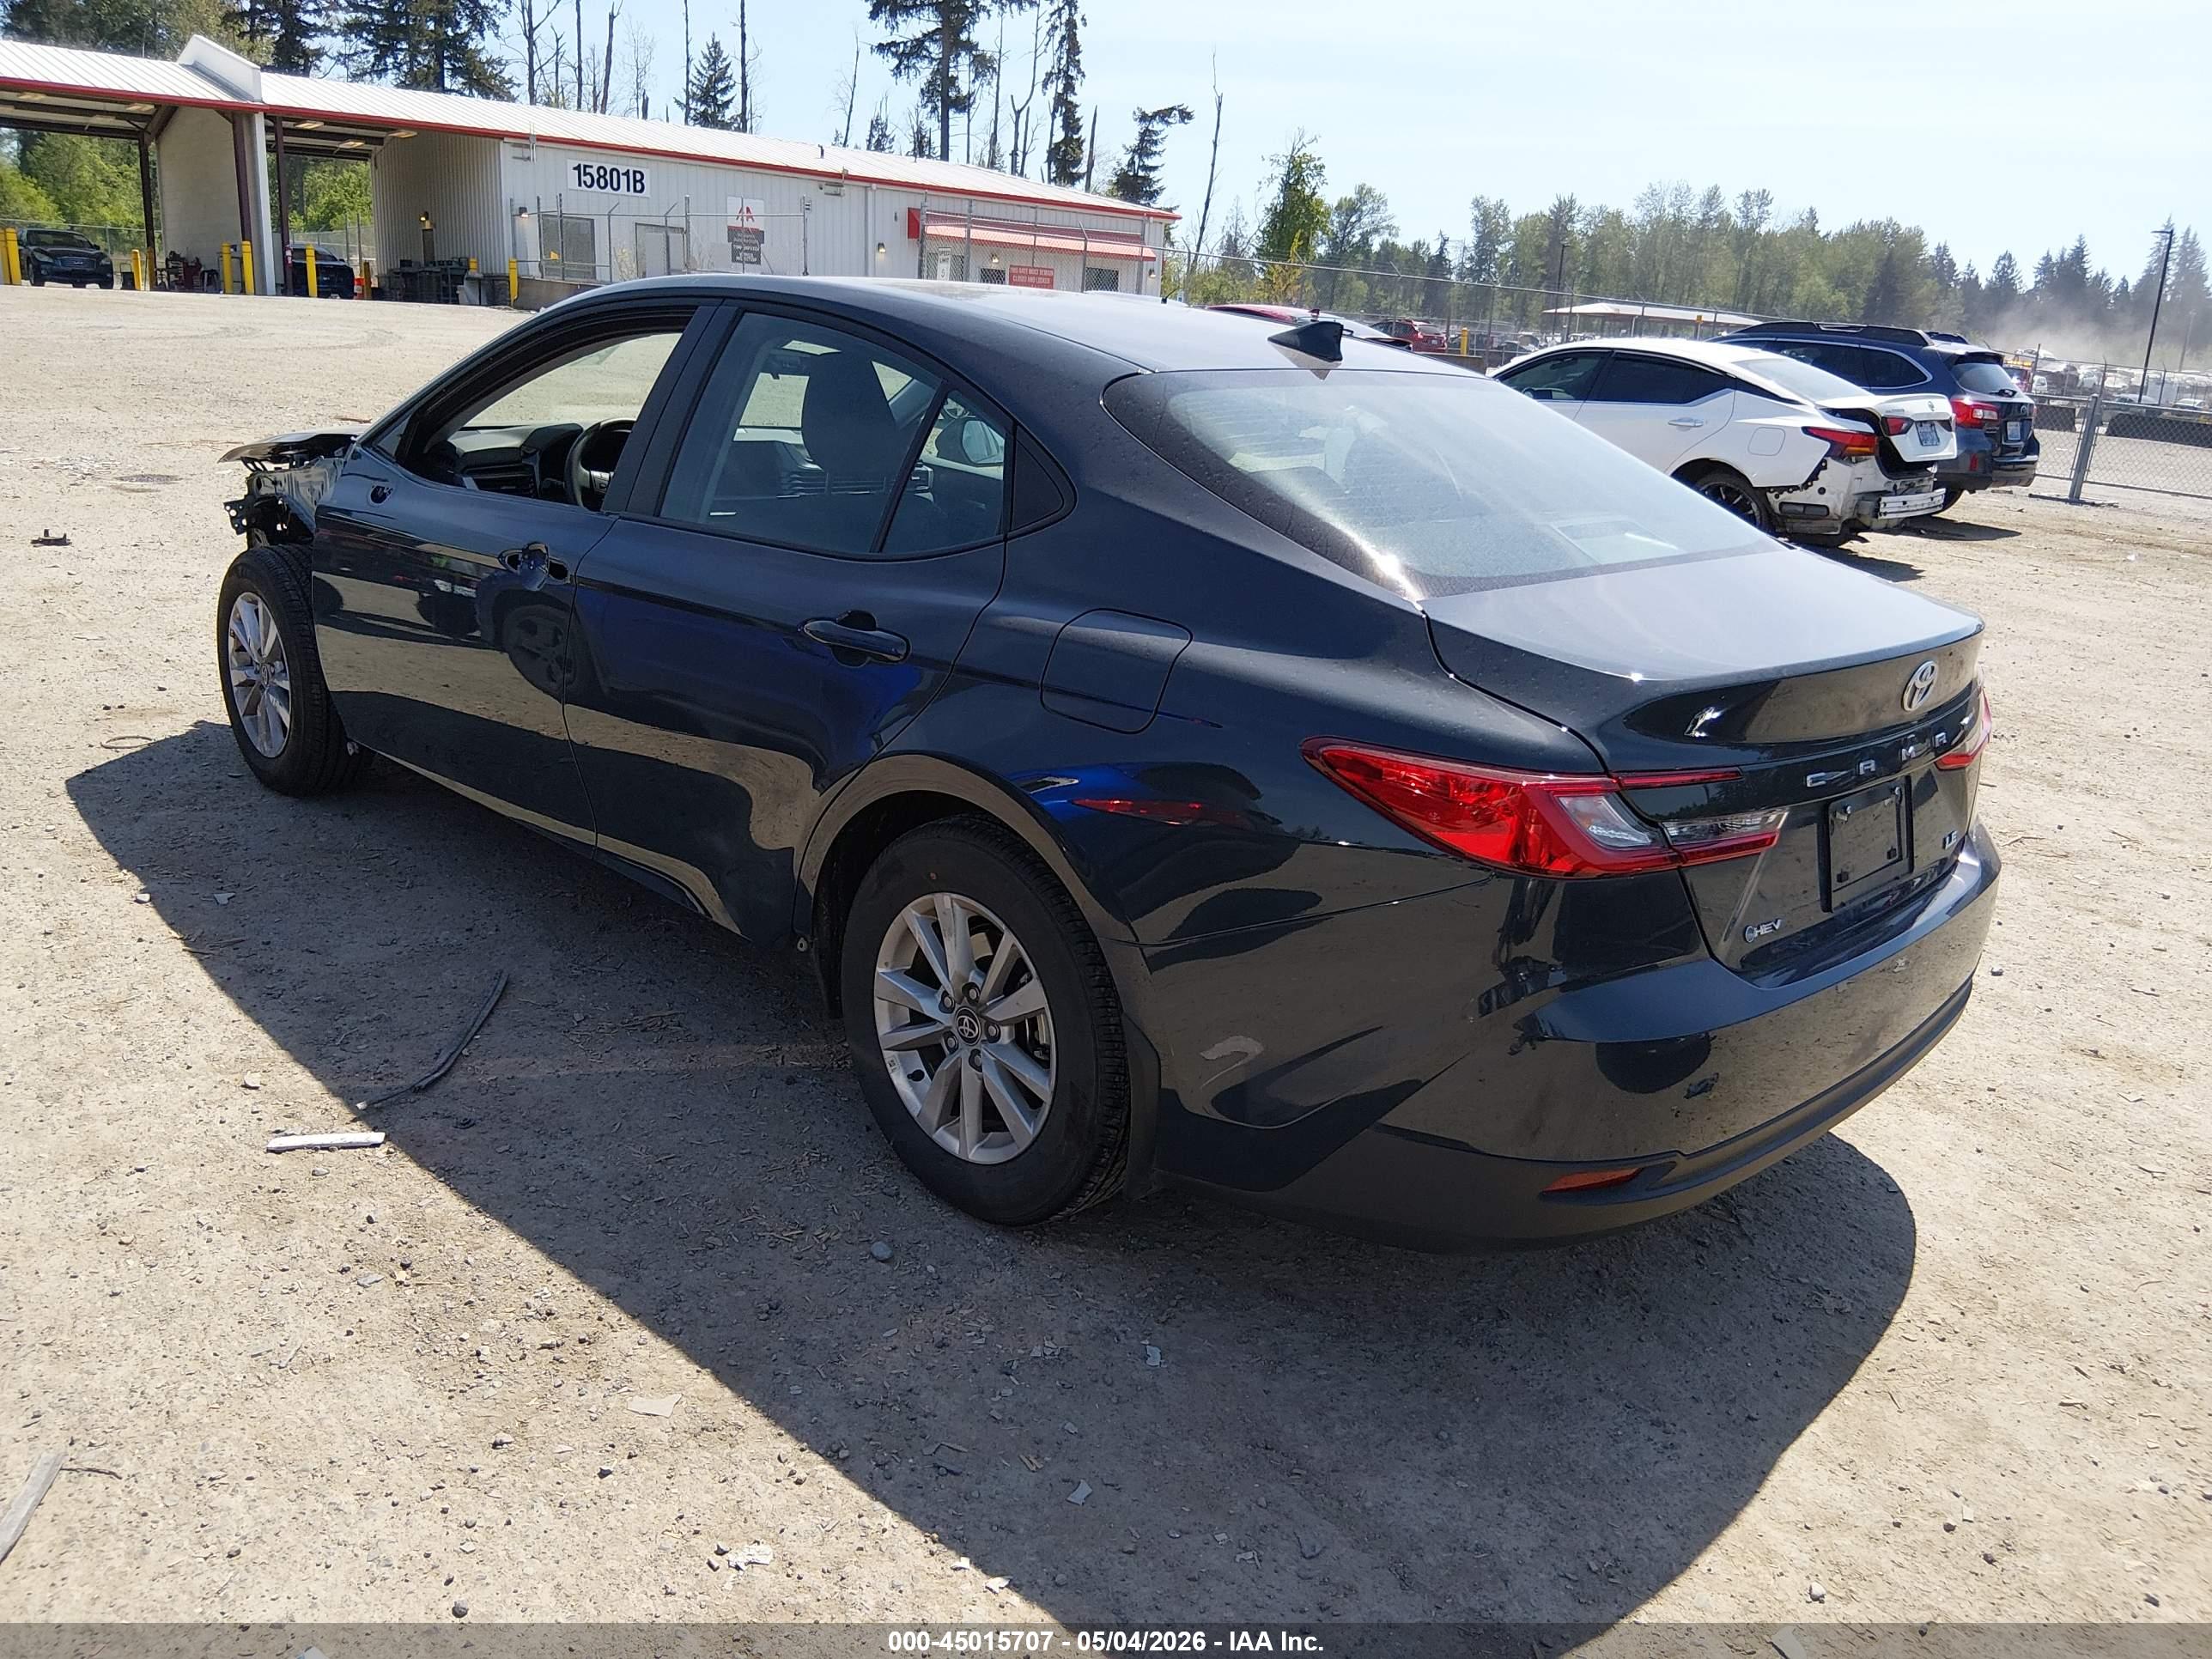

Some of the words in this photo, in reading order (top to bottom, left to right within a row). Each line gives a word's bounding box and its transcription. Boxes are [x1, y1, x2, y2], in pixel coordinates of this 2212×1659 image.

[572, 163, 646, 194] 15801B
[1943, 831, 1957, 850] LE
[1753, 919, 1782, 938] HEV
